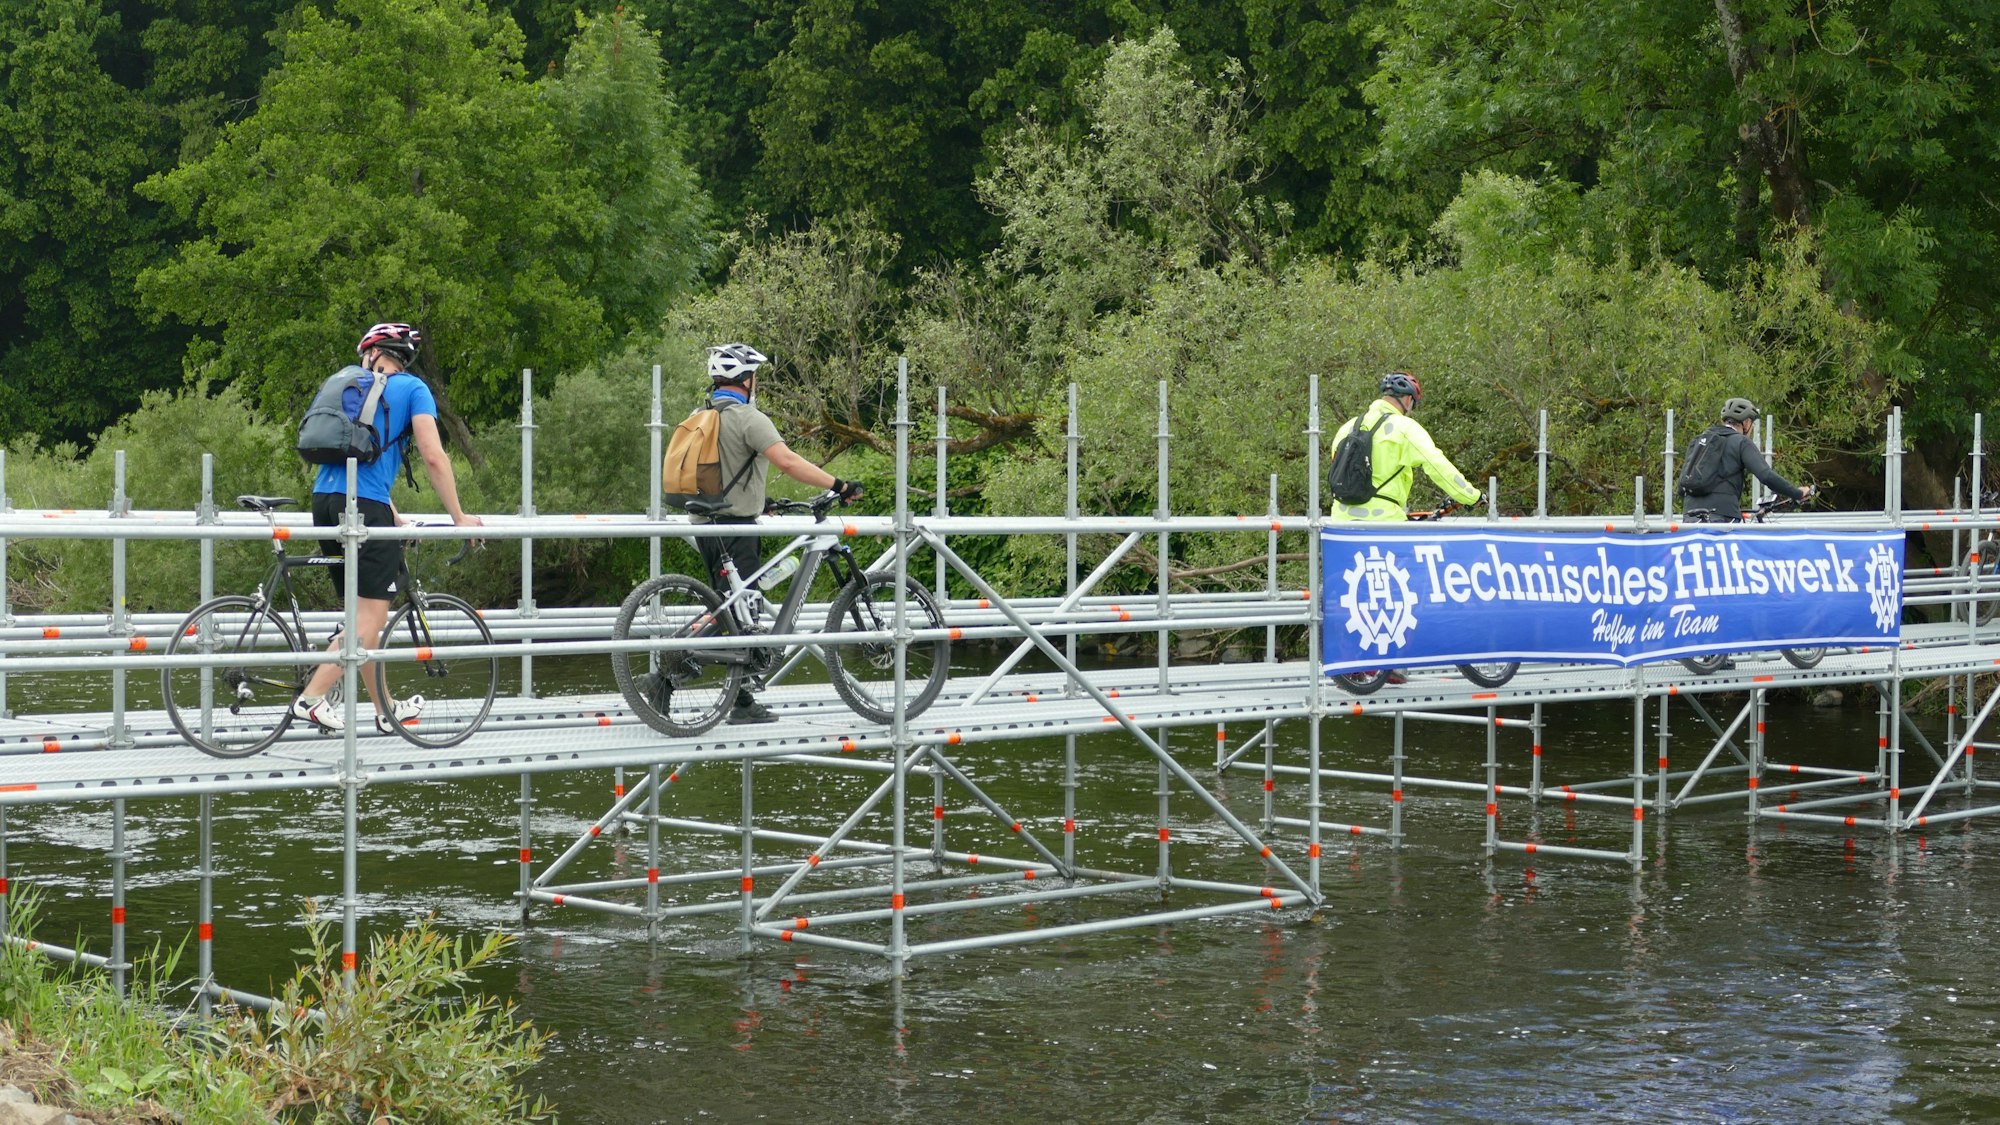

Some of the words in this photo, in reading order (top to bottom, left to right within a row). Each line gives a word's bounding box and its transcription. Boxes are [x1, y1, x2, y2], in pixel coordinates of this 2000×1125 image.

[1413, 543, 1669, 606] Technisches
[1671, 542, 1859, 600] Hilfswerk
[1591, 607, 1636, 653] Helfen
[1640, 617, 1666, 642] im
[1669, 603, 1720, 639] Team
